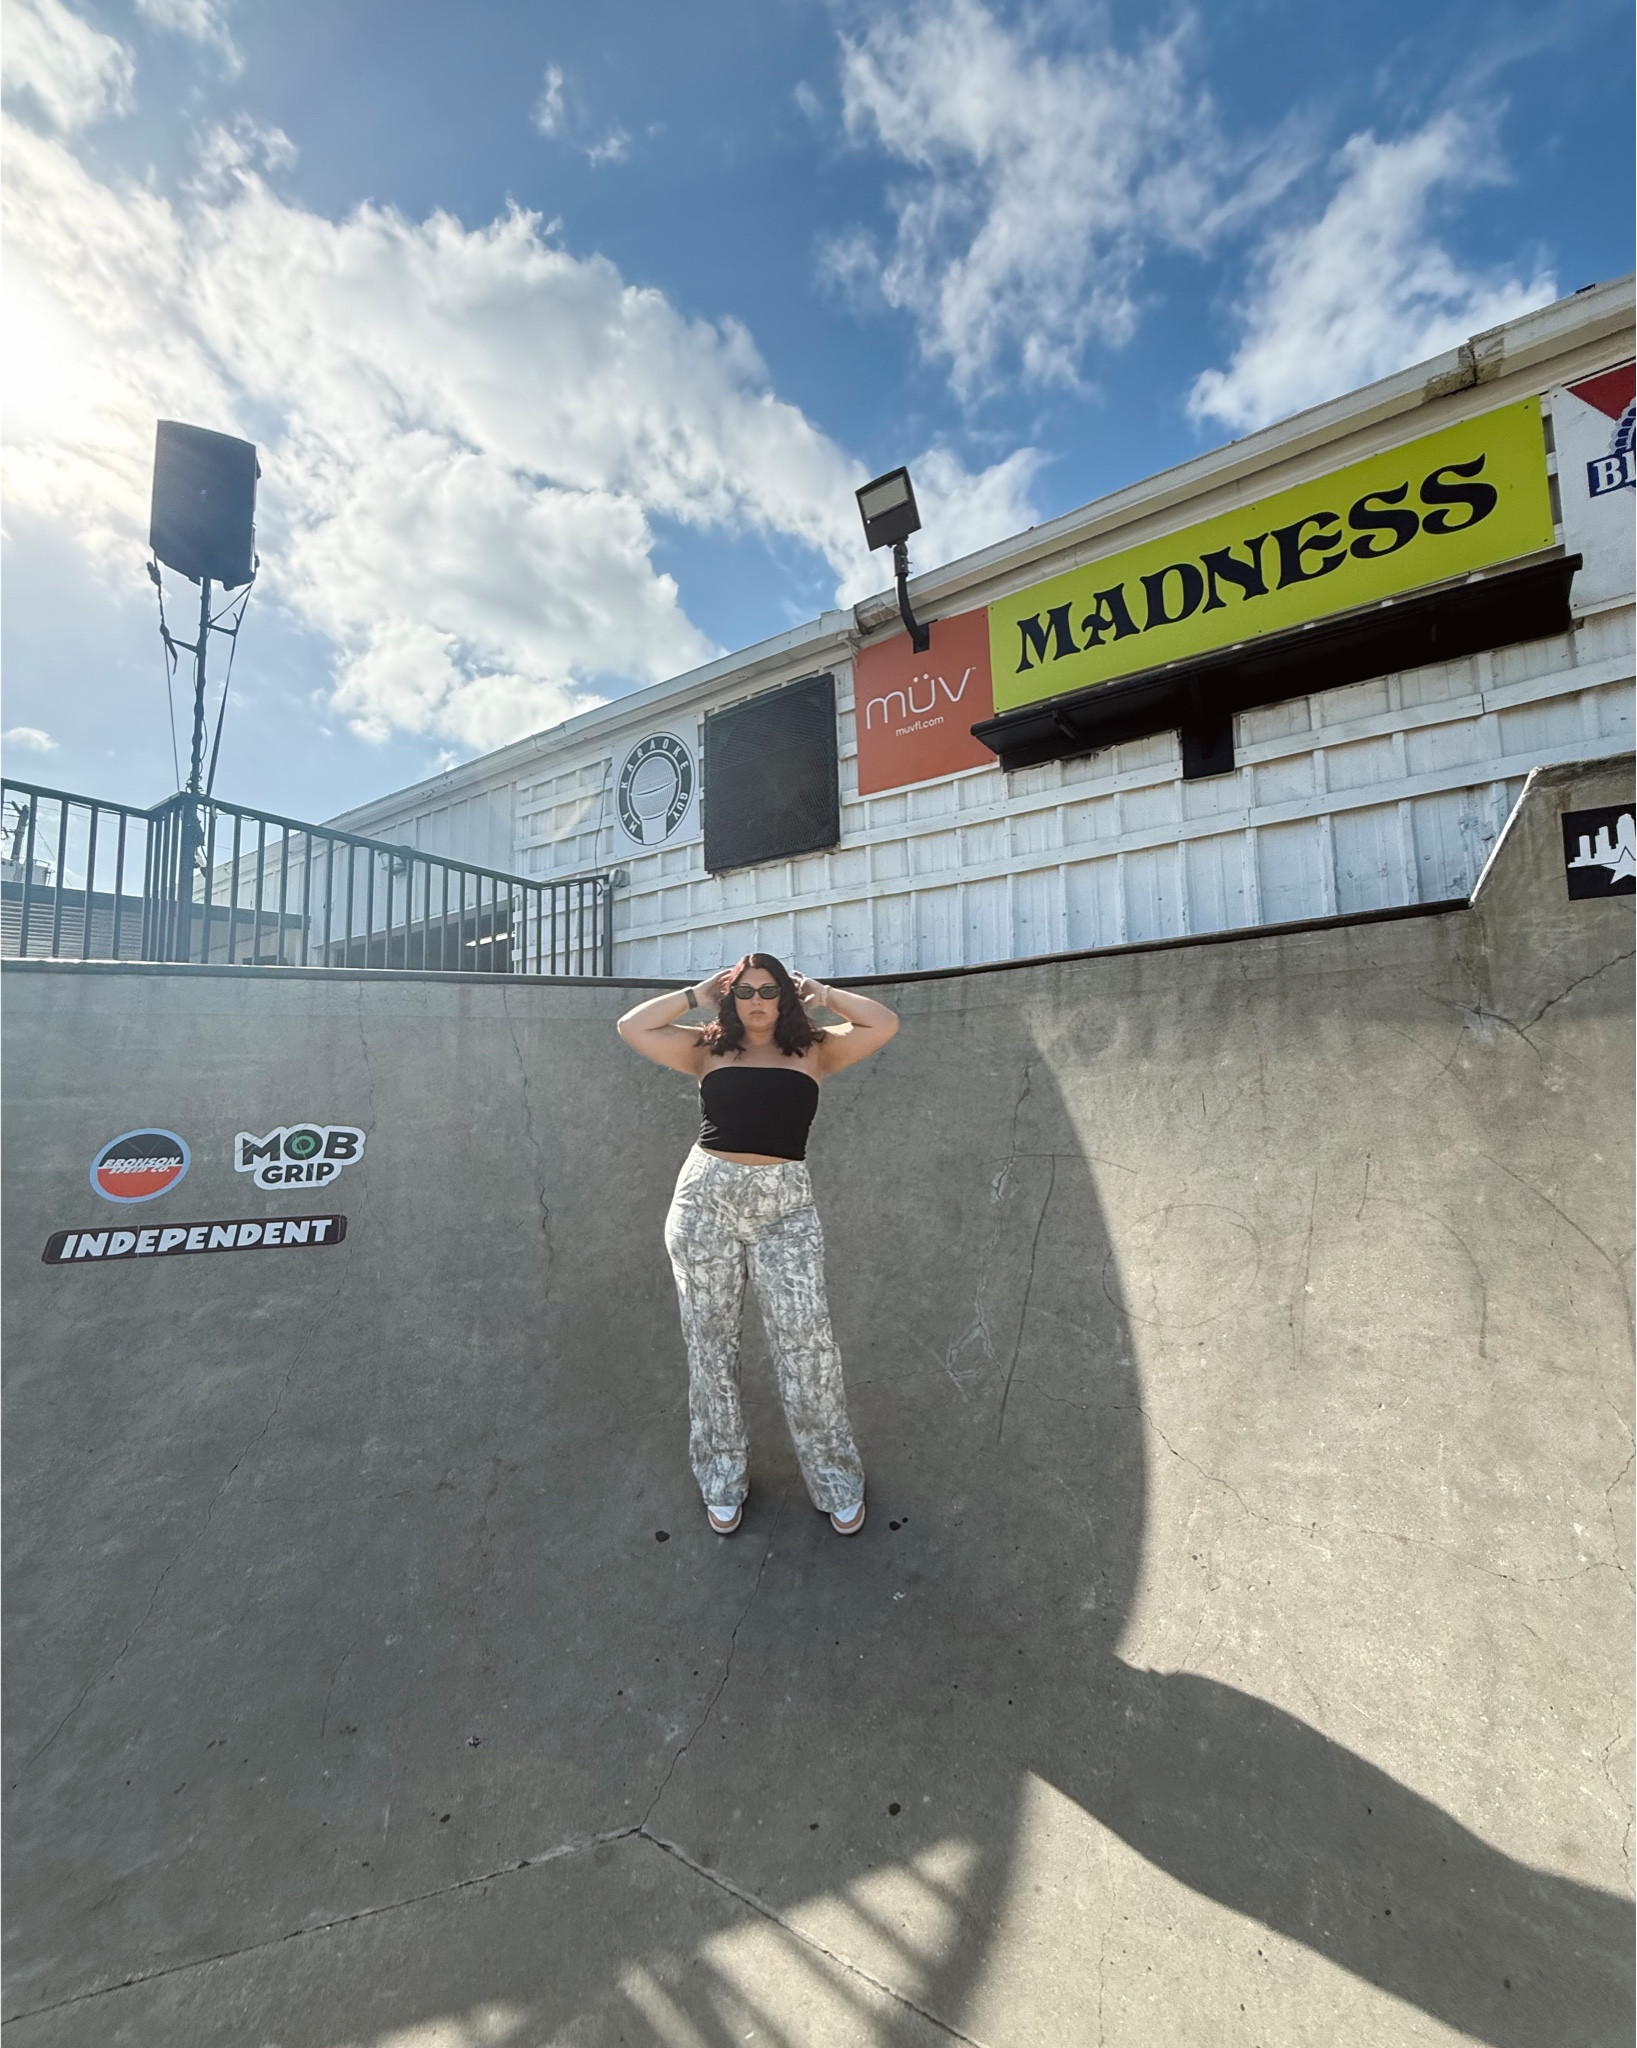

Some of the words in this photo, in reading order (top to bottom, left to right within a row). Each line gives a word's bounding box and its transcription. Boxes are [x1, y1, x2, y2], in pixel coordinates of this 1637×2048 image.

[1015, 453, 1498, 673] MADNESS
[895, 716, 944, 736] muvfl.com
[621, 738, 690, 789] KARAOKE
[672, 792, 688, 820] GUY
[622, 811, 638, 833] MY
[242, 1129, 359, 1166] MOB
[101, 1157, 180, 1169] BRONSON
[261, 1162, 334, 1184] GRIP
[60, 1219, 333, 1259] INDEPENDENT
